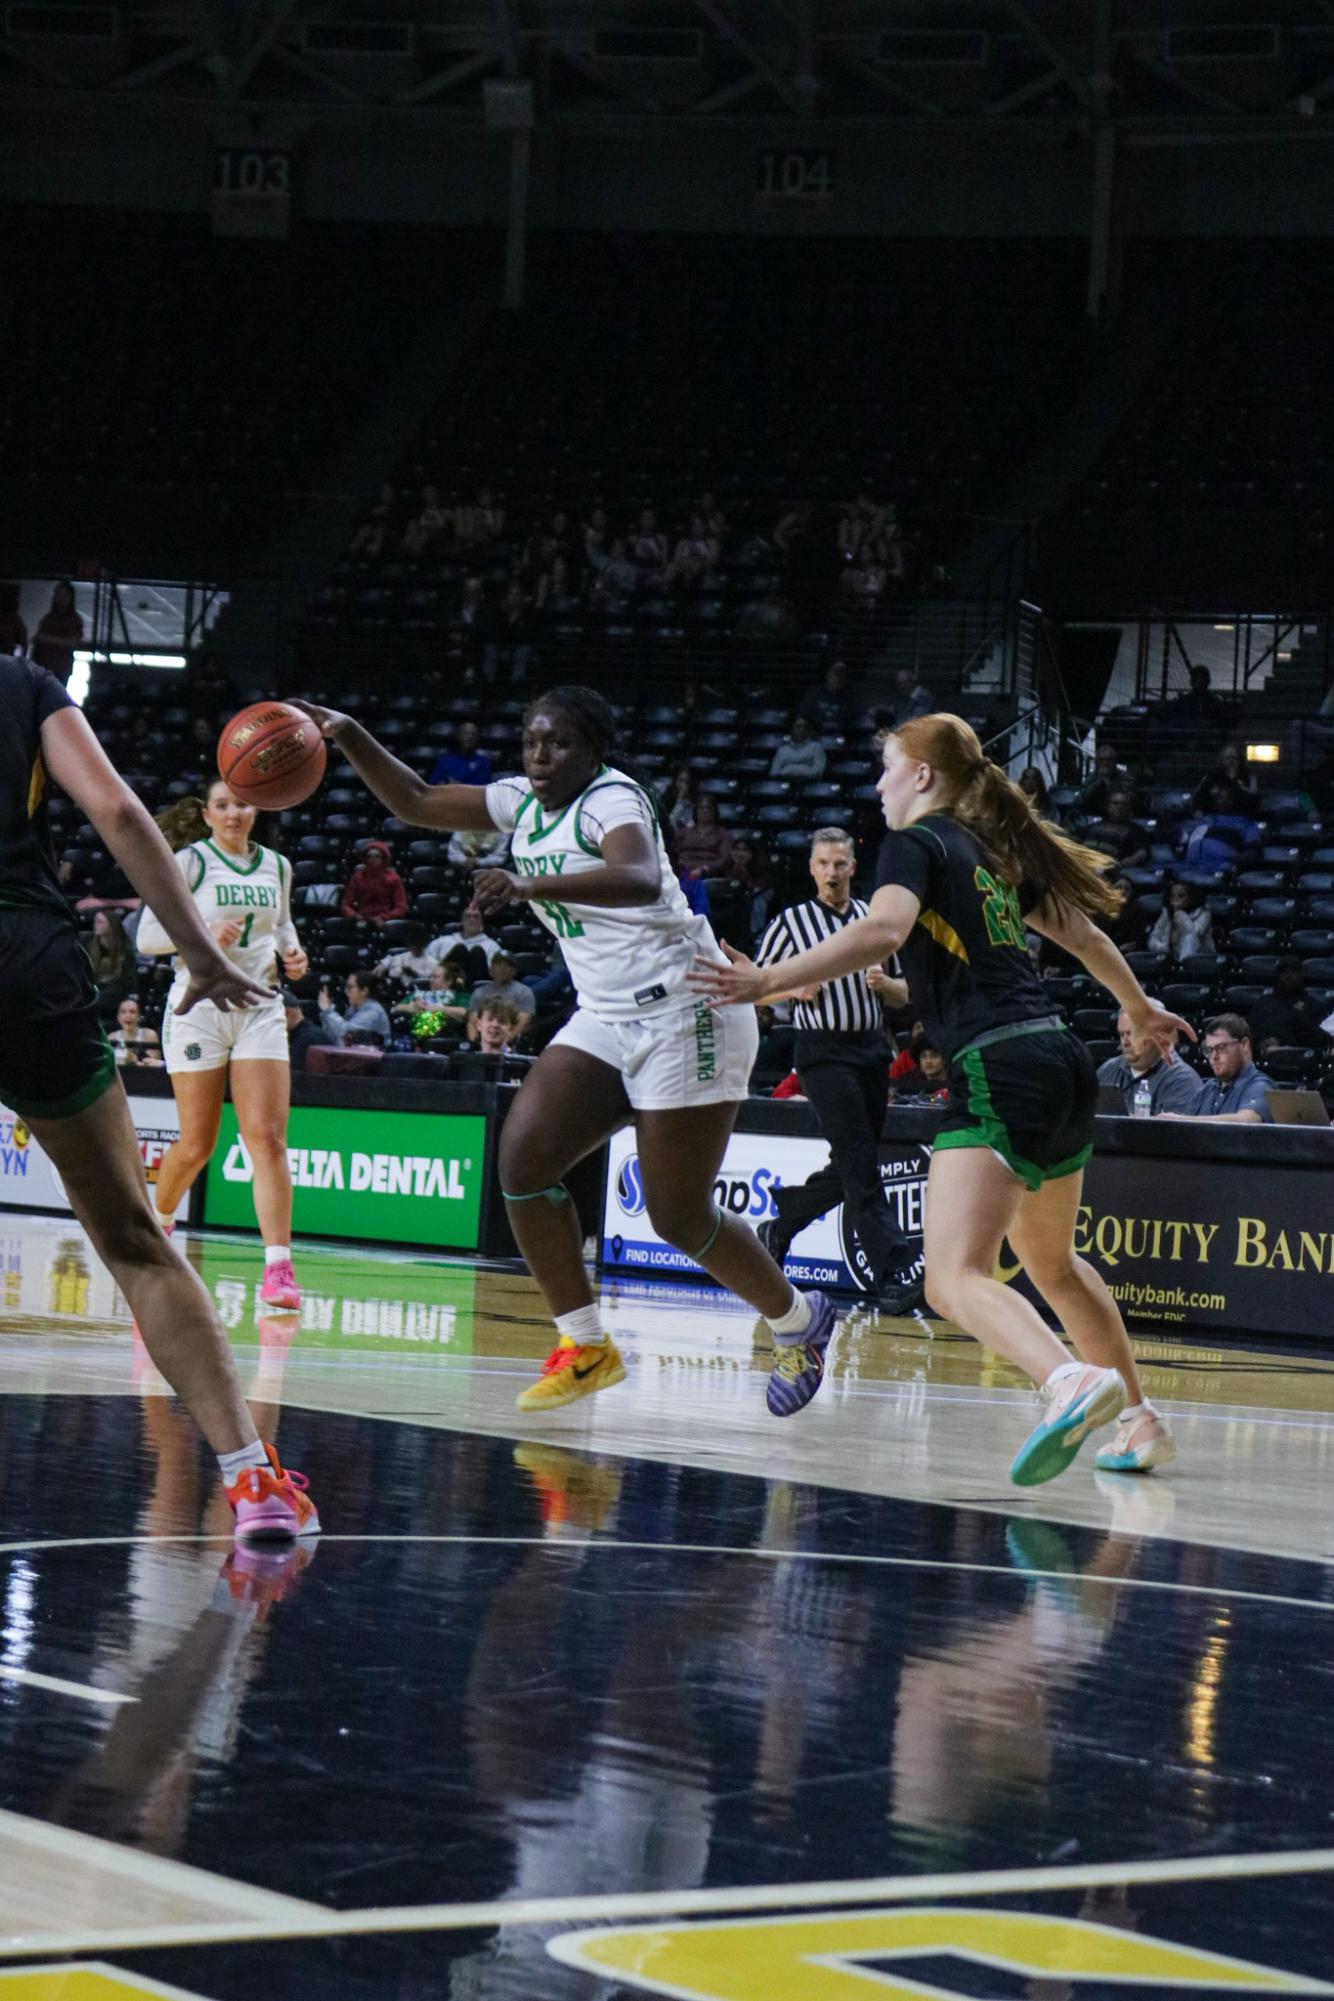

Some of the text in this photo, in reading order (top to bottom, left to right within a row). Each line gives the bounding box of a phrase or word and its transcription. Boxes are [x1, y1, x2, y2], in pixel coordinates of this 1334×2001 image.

[217, 152, 289, 193] 103
[762, 155, 832, 194] 104
[215, 884, 277, 909] DERBY
[239, 912, 255, 948] 1
[0, 1149, 29, 1177] YN
[350, 1152, 465, 1199] DENTAL
[880, 1158, 921, 1178] MPLY
[1073, 1206, 1220, 1266] EQUITY
[626, 1248, 647, 1263] FIND
[784, 1266, 838, 1282] ORES.COM
